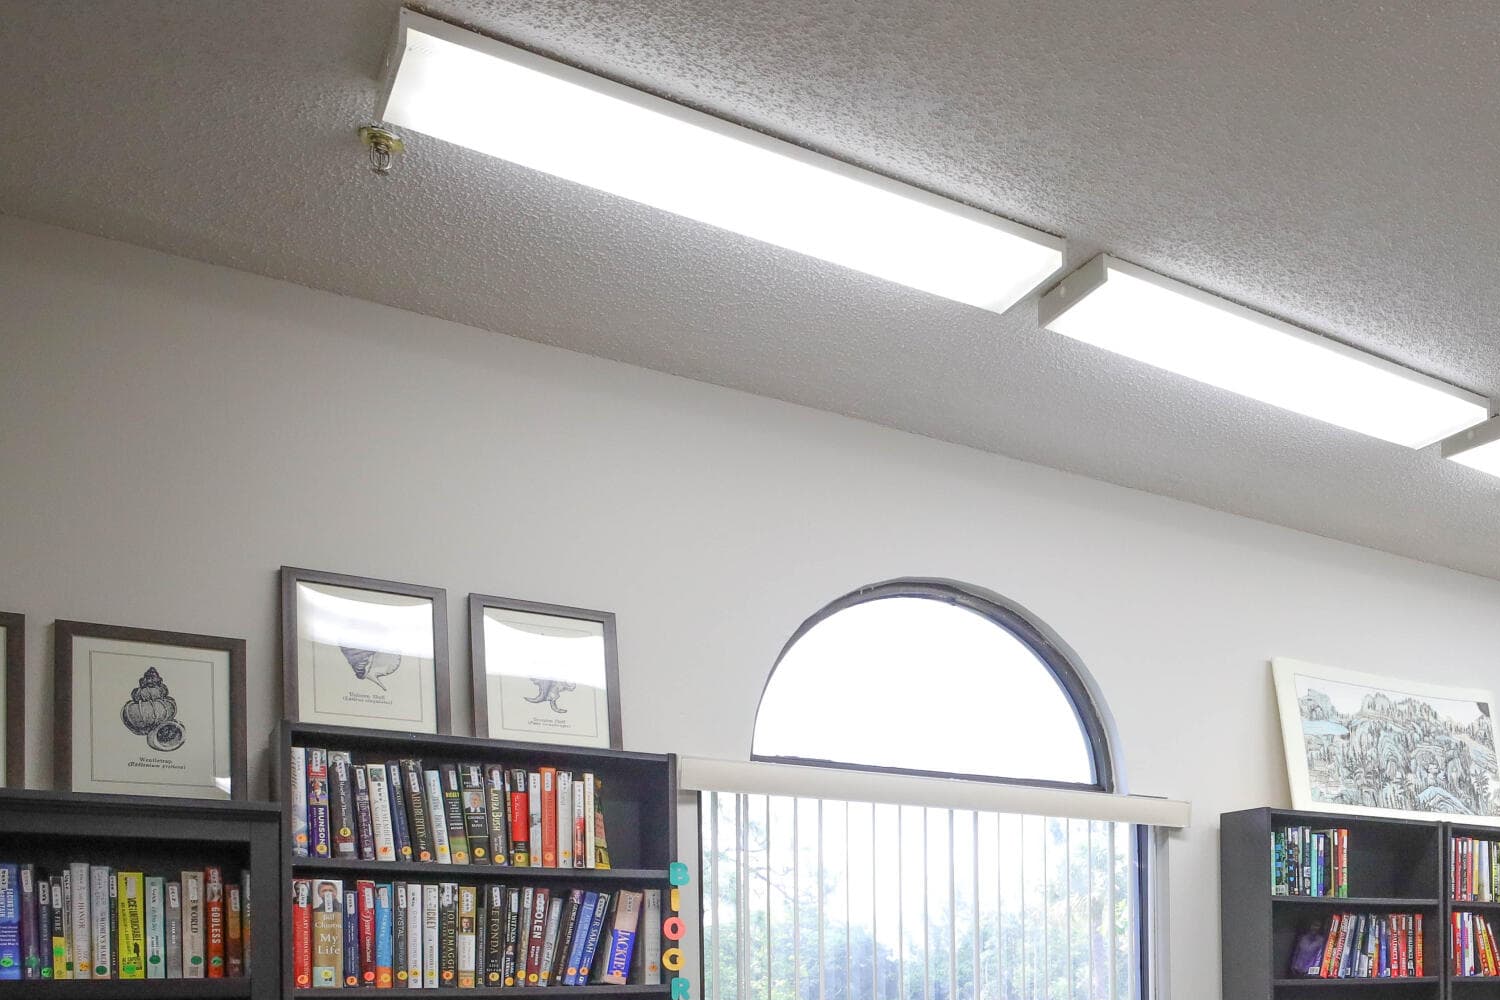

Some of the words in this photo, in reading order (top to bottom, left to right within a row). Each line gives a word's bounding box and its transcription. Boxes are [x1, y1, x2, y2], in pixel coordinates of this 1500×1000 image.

[490, 788, 500, 810] LAURA
[492, 812, 502, 831] BUSH
[190, 906, 198, 933] WORLD
[211, 907, 221, 944] GODLESS
[320, 934, 338, 945] My
[490, 919, 500, 954] FONDA
[318, 946, 340, 954] Life
[614, 931, 631, 969] JACKIE
